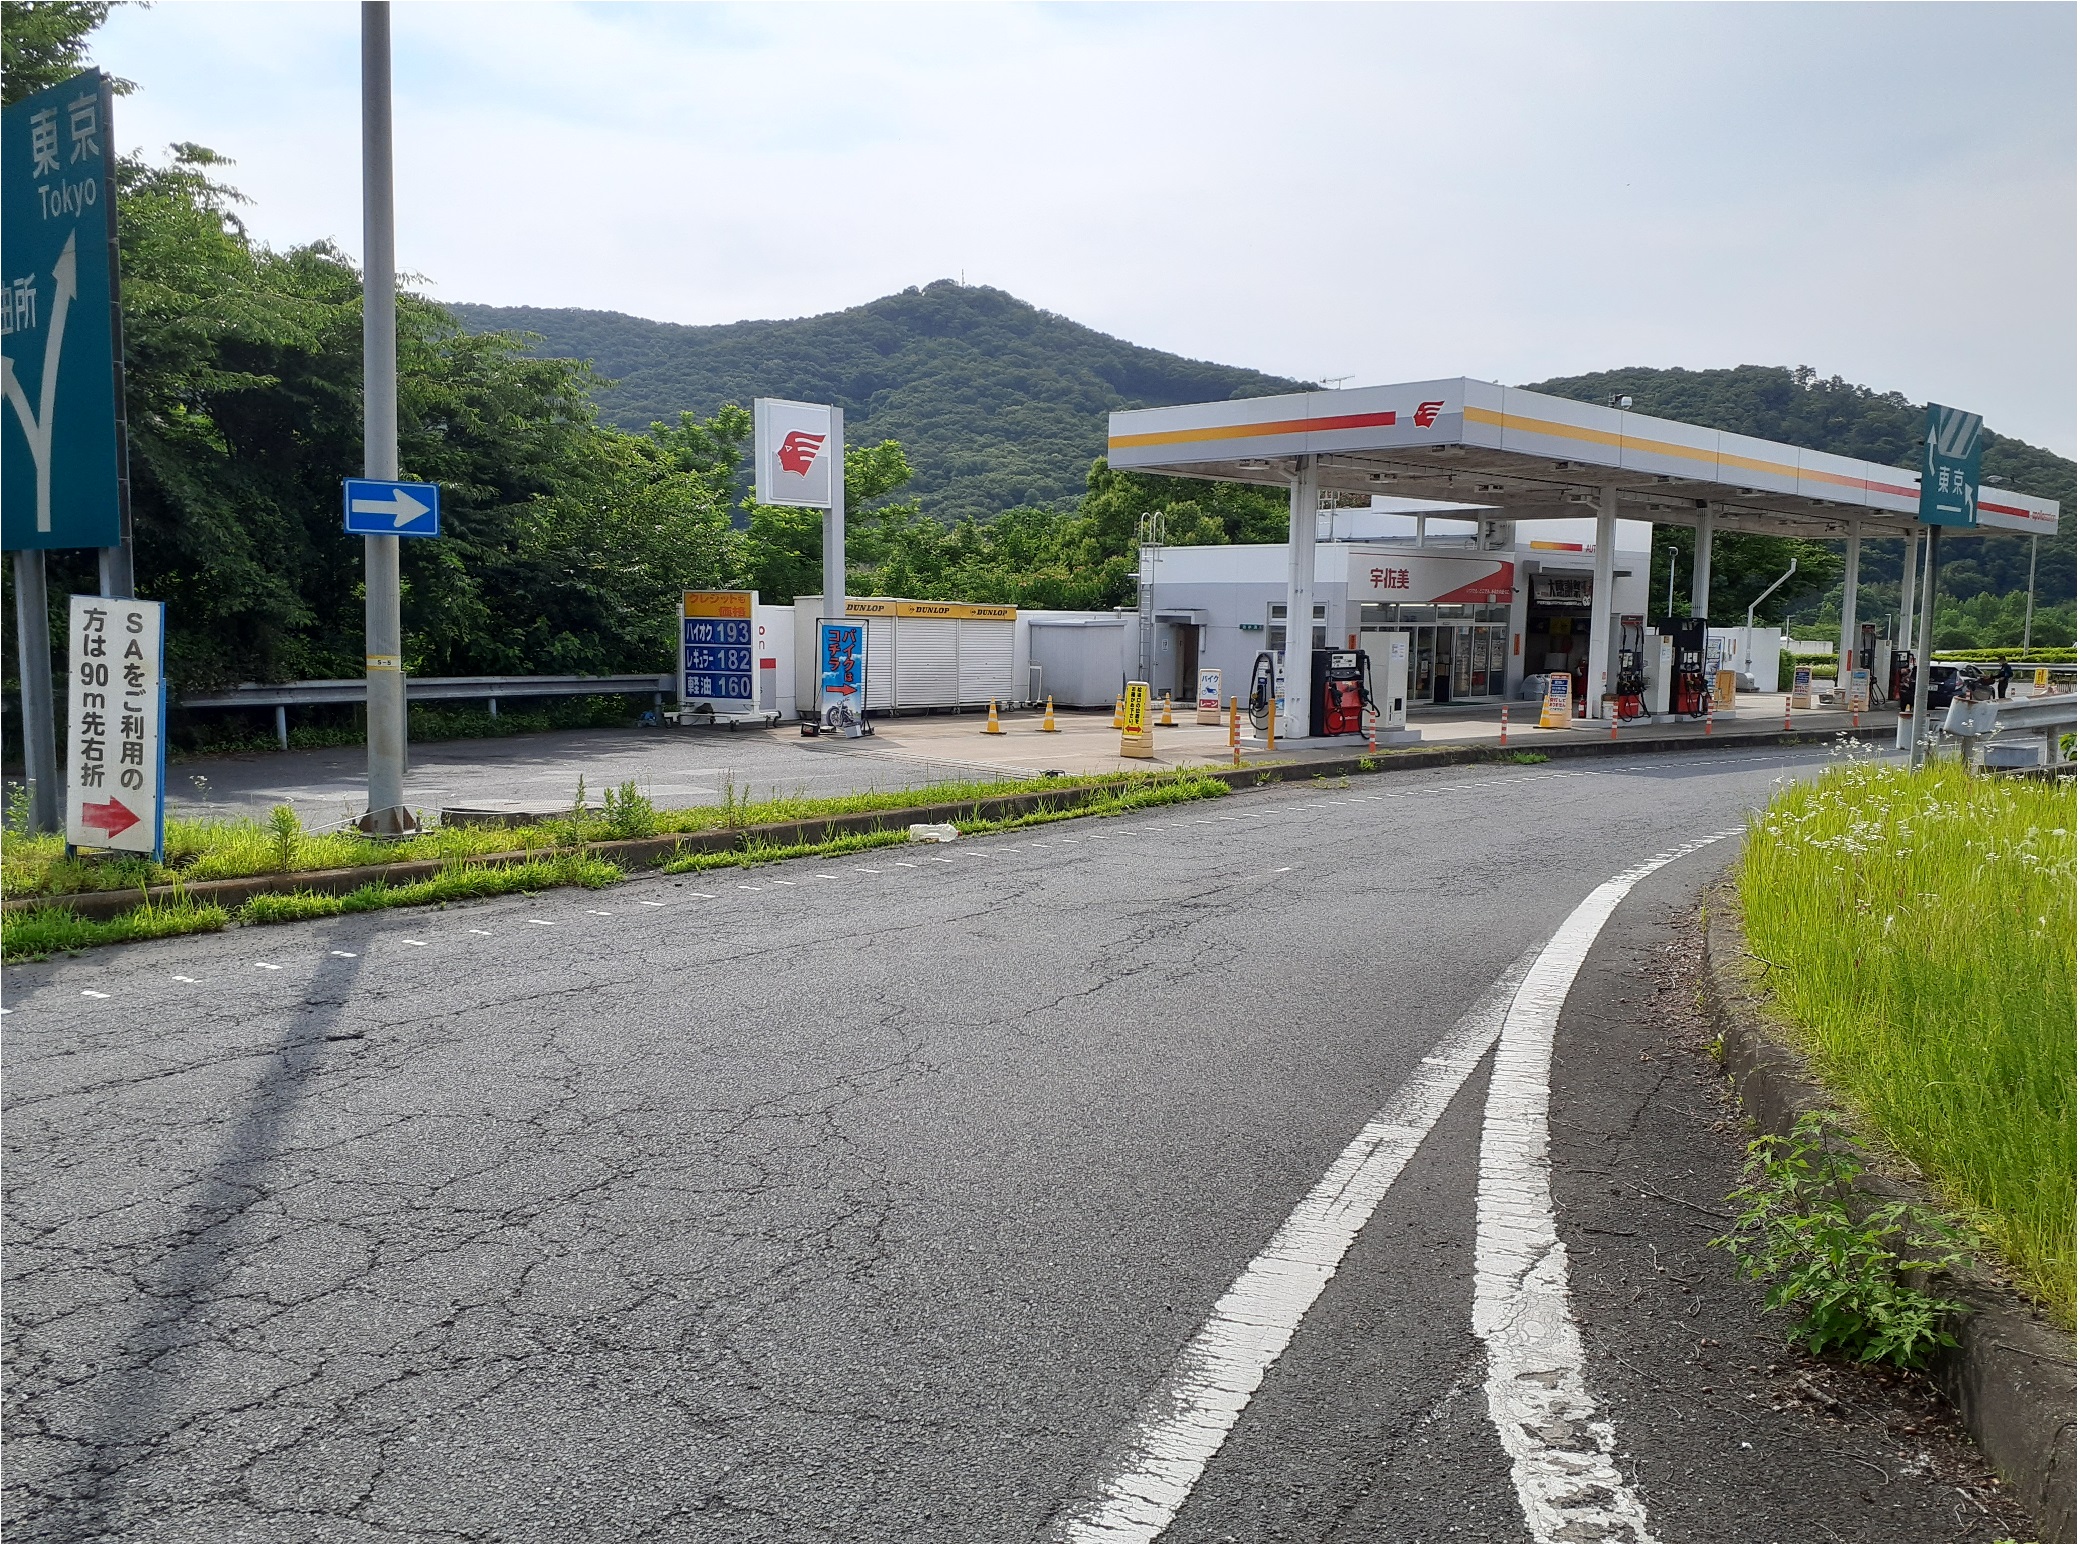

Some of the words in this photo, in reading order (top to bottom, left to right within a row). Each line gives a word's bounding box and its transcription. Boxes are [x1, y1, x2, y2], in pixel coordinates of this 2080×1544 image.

[29, 91, 100, 180] 東京
[38, 178, 97, 220] Tokyo
[1937, 465, 1965, 496] 東京
[1585, 544, 1597, 554] AUT
[1370, 567, 1410, 590] 宇佐美
[688, 593, 746, 604] クレジットも
[846, 603, 885, 613] DUNLOP
[915, 606, 950, 614] DUNLOP
[976, 608, 1008, 617] DUNLOP
[686, 622, 713, 642] ハイオク
[717, 622, 749, 643] 193
[686, 649, 714, 668] レギュラー
[717, 649, 750, 670] 182
[827, 630, 842, 672] コチラ
[842, 628, 857, 683] バイクは
[687, 675, 712, 696] 軽油
[719, 676, 751, 697] 160
[1200, 675, 1219, 683] バイク
[80, 607, 109, 788] 方は90m先右折
[120, 612, 146, 791] SAをご利用の
